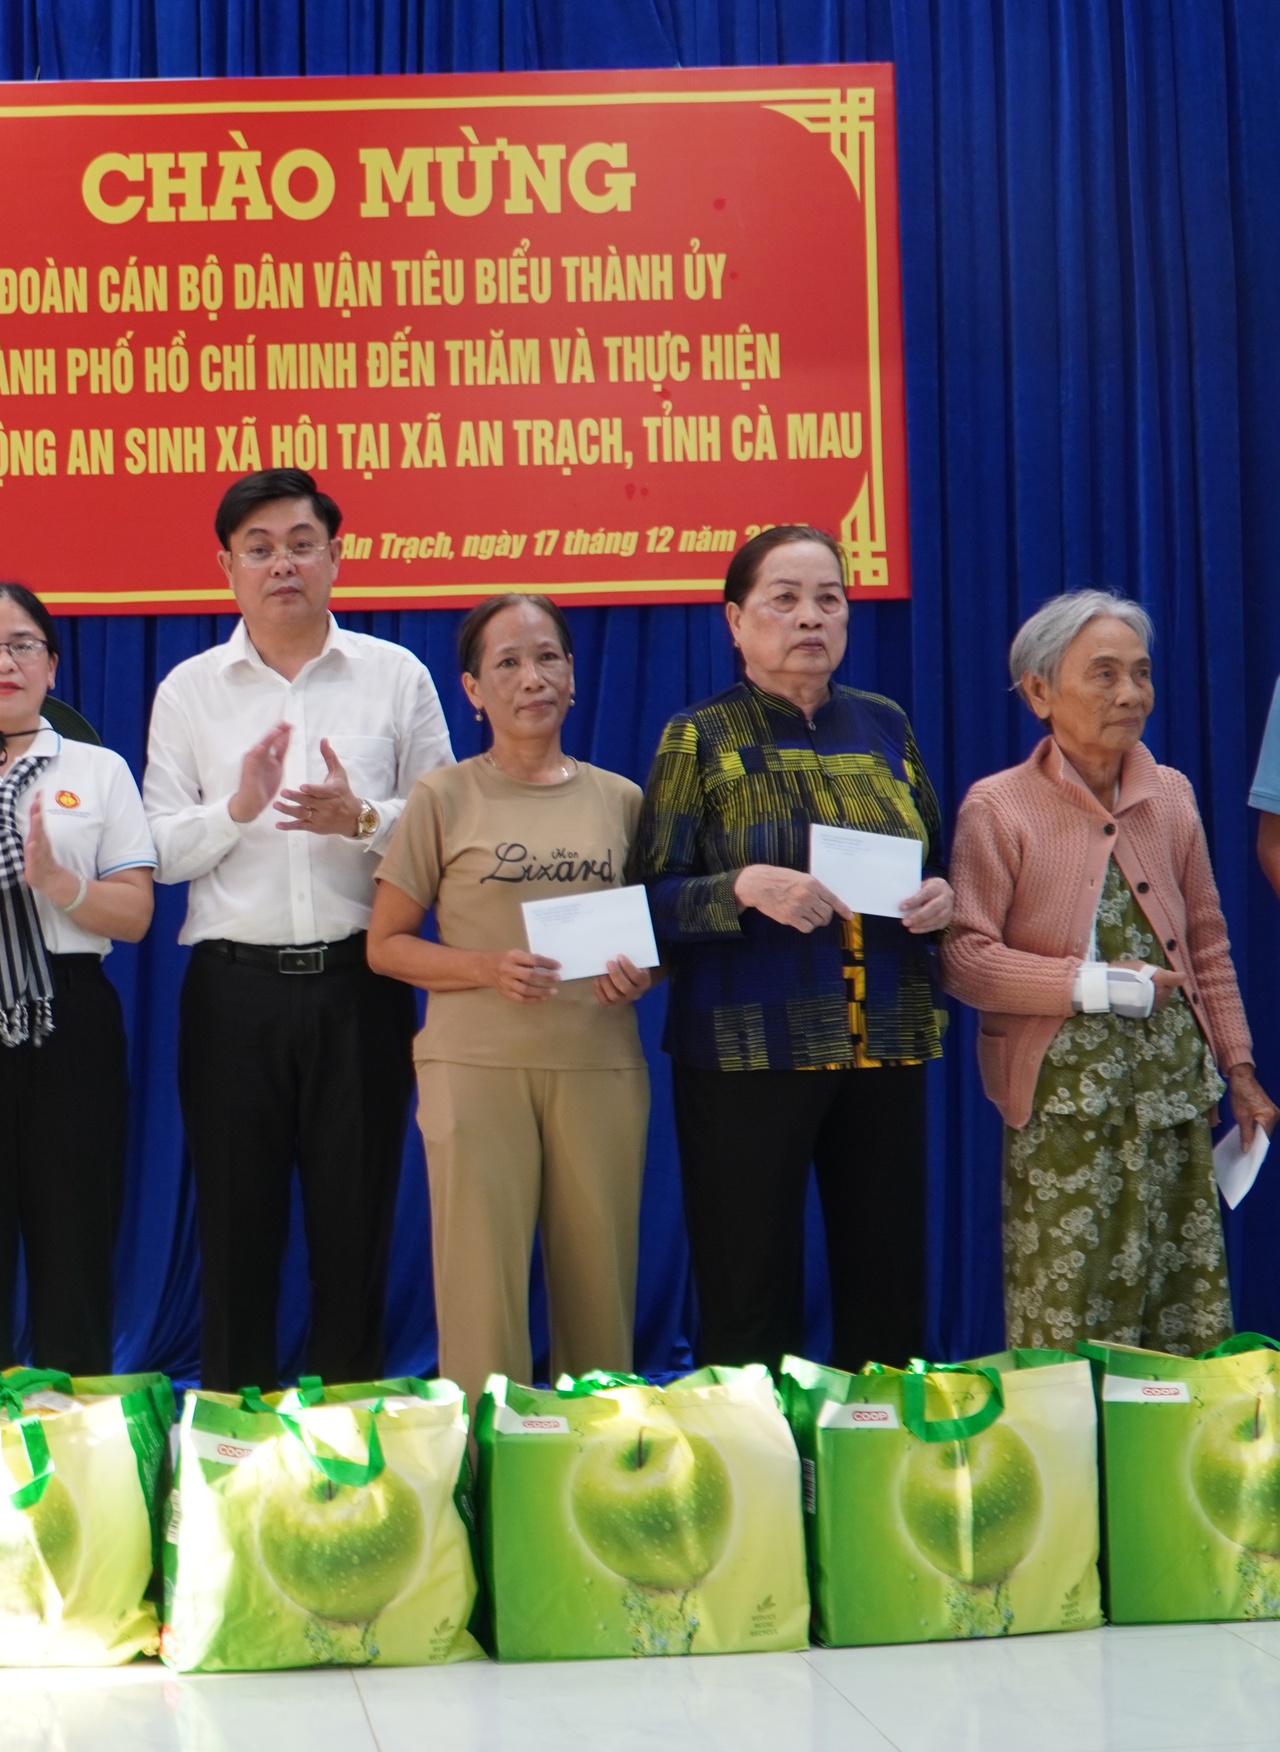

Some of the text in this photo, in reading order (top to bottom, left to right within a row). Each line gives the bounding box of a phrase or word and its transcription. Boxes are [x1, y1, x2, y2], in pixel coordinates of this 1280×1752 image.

[82, 126, 637, 224] CHÀO MỪNG
[98, 256, 168, 313] CÁN
[178, 254, 223, 321] BỘ
[234, 253, 304, 310] DÂN
[313, 251, 382, 318] VẬN
[391, 249, 465, 306] TIÊU
[475, 238, 552, 305] BIỂU
[561, 245, 674, 303] THÀNH
[683, 238, 727, 301] ỦY
[66, 330, 134, 394] PHỐ
[144, 330, 189, 393] HỒ
[200, 334, 256, 392] CHÍ
[267, 342, 357, 390] MINH
[366, 326, 435, 388] ĐẾN
[444, 329, 541, 386] THĂM
[550, 327, 595, 384] VÀ
[603, 330, 691, 392] THỰC
[701, 323, 781, 391] HIỆN
[67, 428, 114, 475] AN
[125, 426, 206, 475] SINH
[215, 416, 262, 472] XÃ
[337, 422, 390, 480] TẠI
[400, 412, 447, 469] XÃ
[455, 420, 504, 468] AN
[512, 417, 633, 476] TRẠCH,
[642, 401, 721, 463] TỈNH
[731, 405, 778, 462] CÀ
[787, 411, 863, 460] MAU
[341, 533, 373, 560] An
[380, 531, 455, 564] Trạch,
[461, 530, 527, 560] ngày
[534, 529, 560, 556] 17
[563, 527, 639, 557] tháng
[646, 525, 675, 553] 12
[678, 525, 737, 553] năm
[480, 843, 615, 884] Lizard
[1142, 1387, 1180, 1396] COOP
[523, 1420, 560, 1429] COOP
[852, 1410, 889, 1421] COOP
